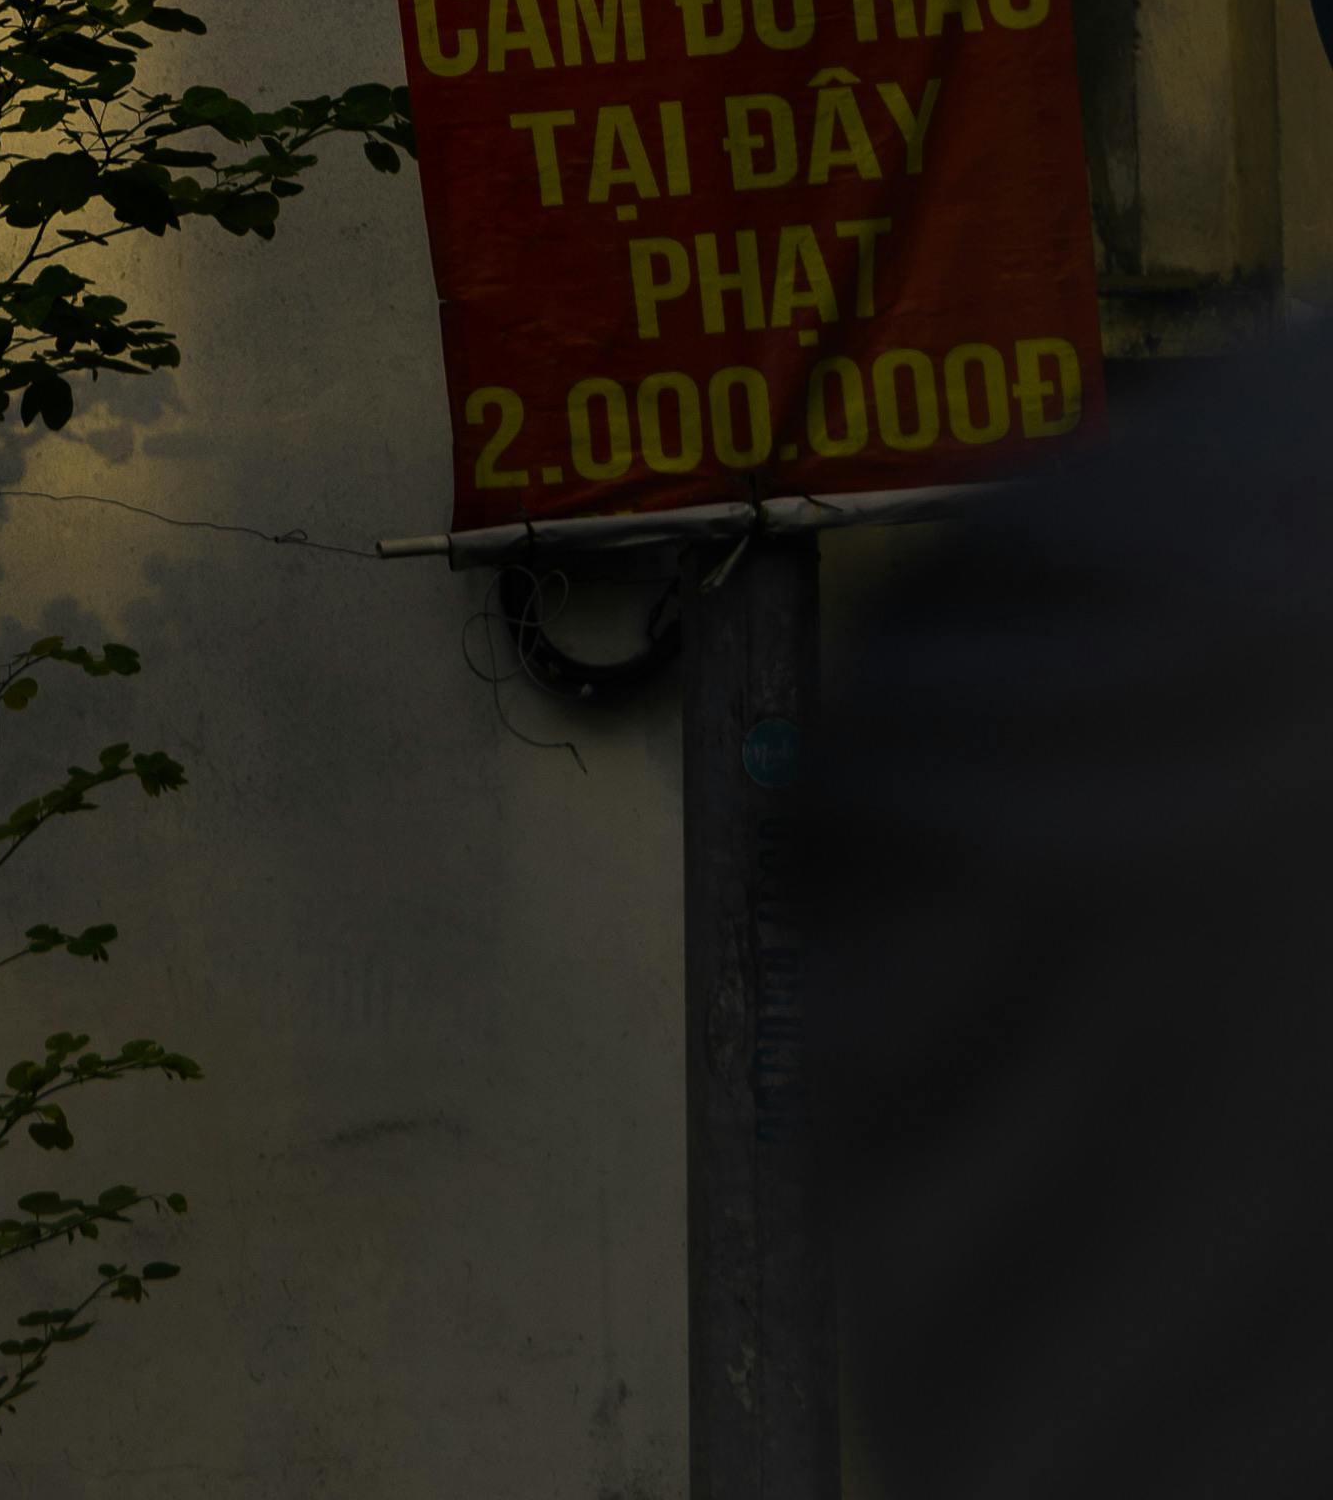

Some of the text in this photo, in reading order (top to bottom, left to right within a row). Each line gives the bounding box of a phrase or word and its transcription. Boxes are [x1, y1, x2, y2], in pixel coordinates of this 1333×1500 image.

[509, 66, 942, 221] TẠI ĐÂY
[628, 217, 893, 348] PHẠT
[465, 336, 1084, 489] 2.000.000Đ
